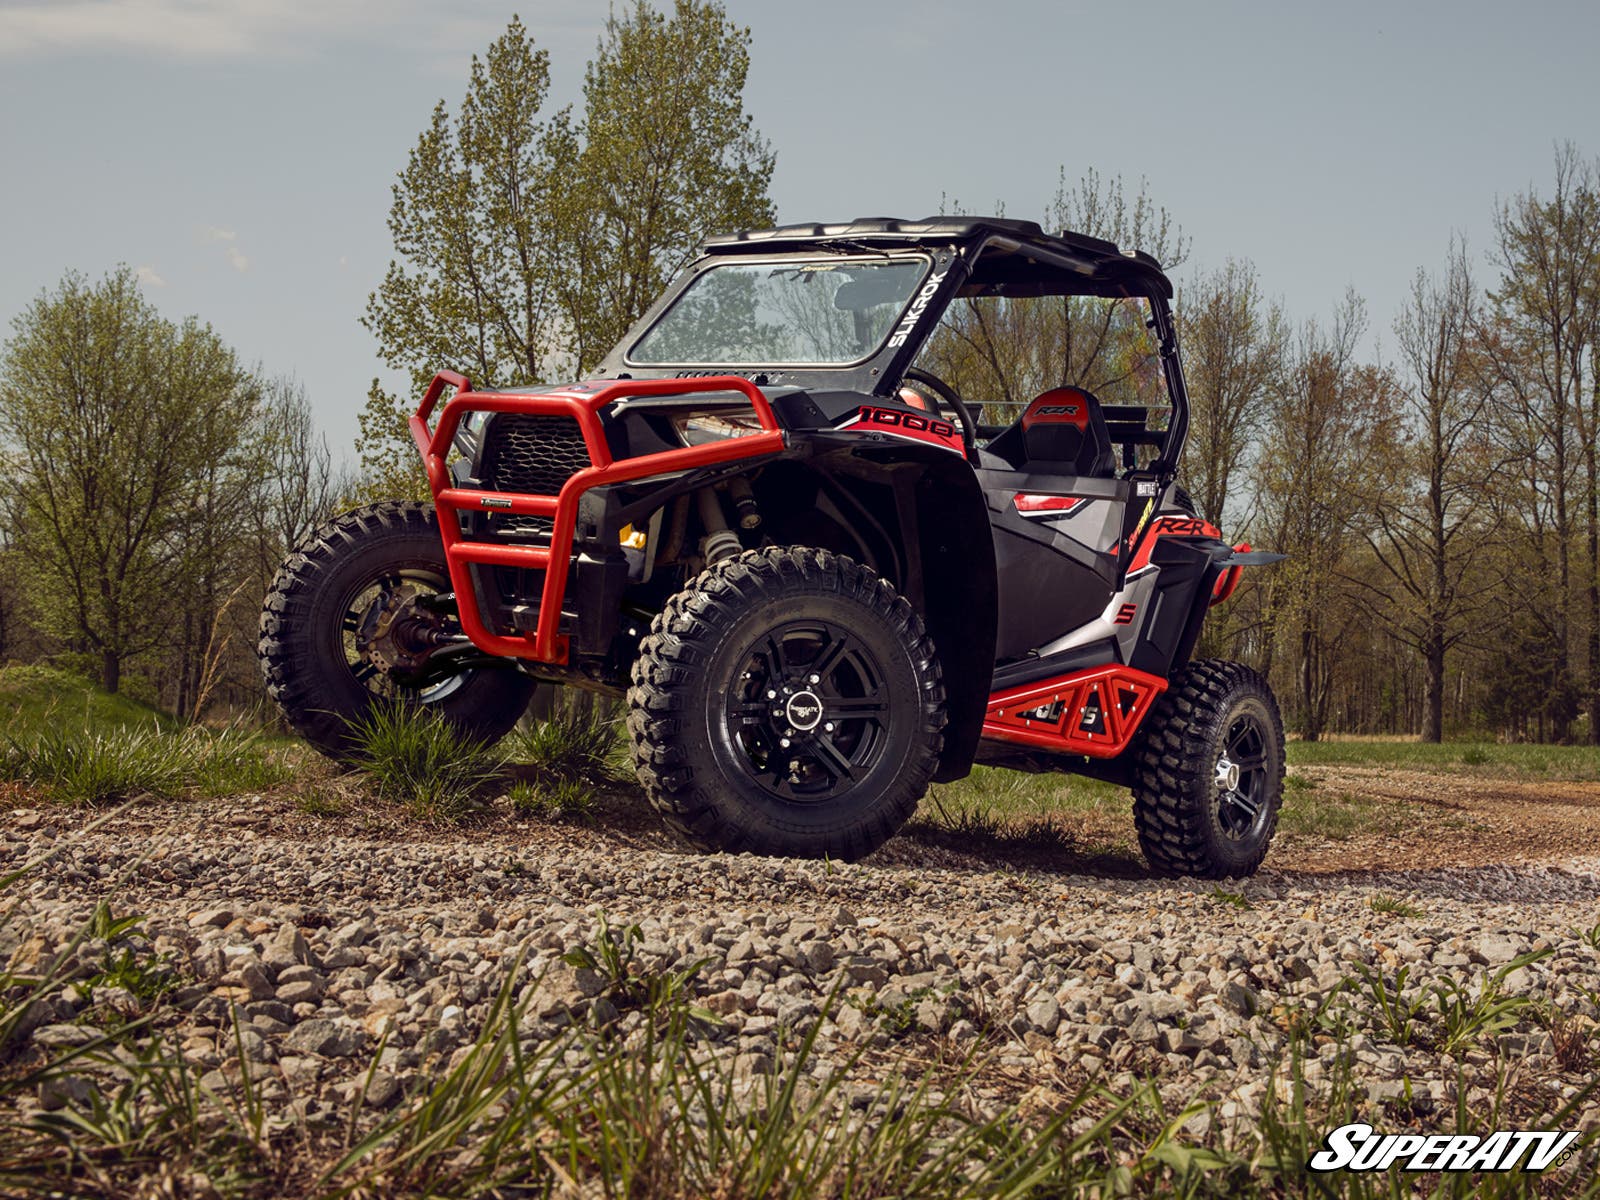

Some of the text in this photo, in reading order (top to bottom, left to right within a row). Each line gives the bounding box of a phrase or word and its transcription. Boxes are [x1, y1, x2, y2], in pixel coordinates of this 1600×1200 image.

[888, 271, 948, 348] SLIKROK
[859, 406, 954, 438] 1000
[1033, 405, 1080, 417] RZR
[1155, 517, 1205, 536] RZR
